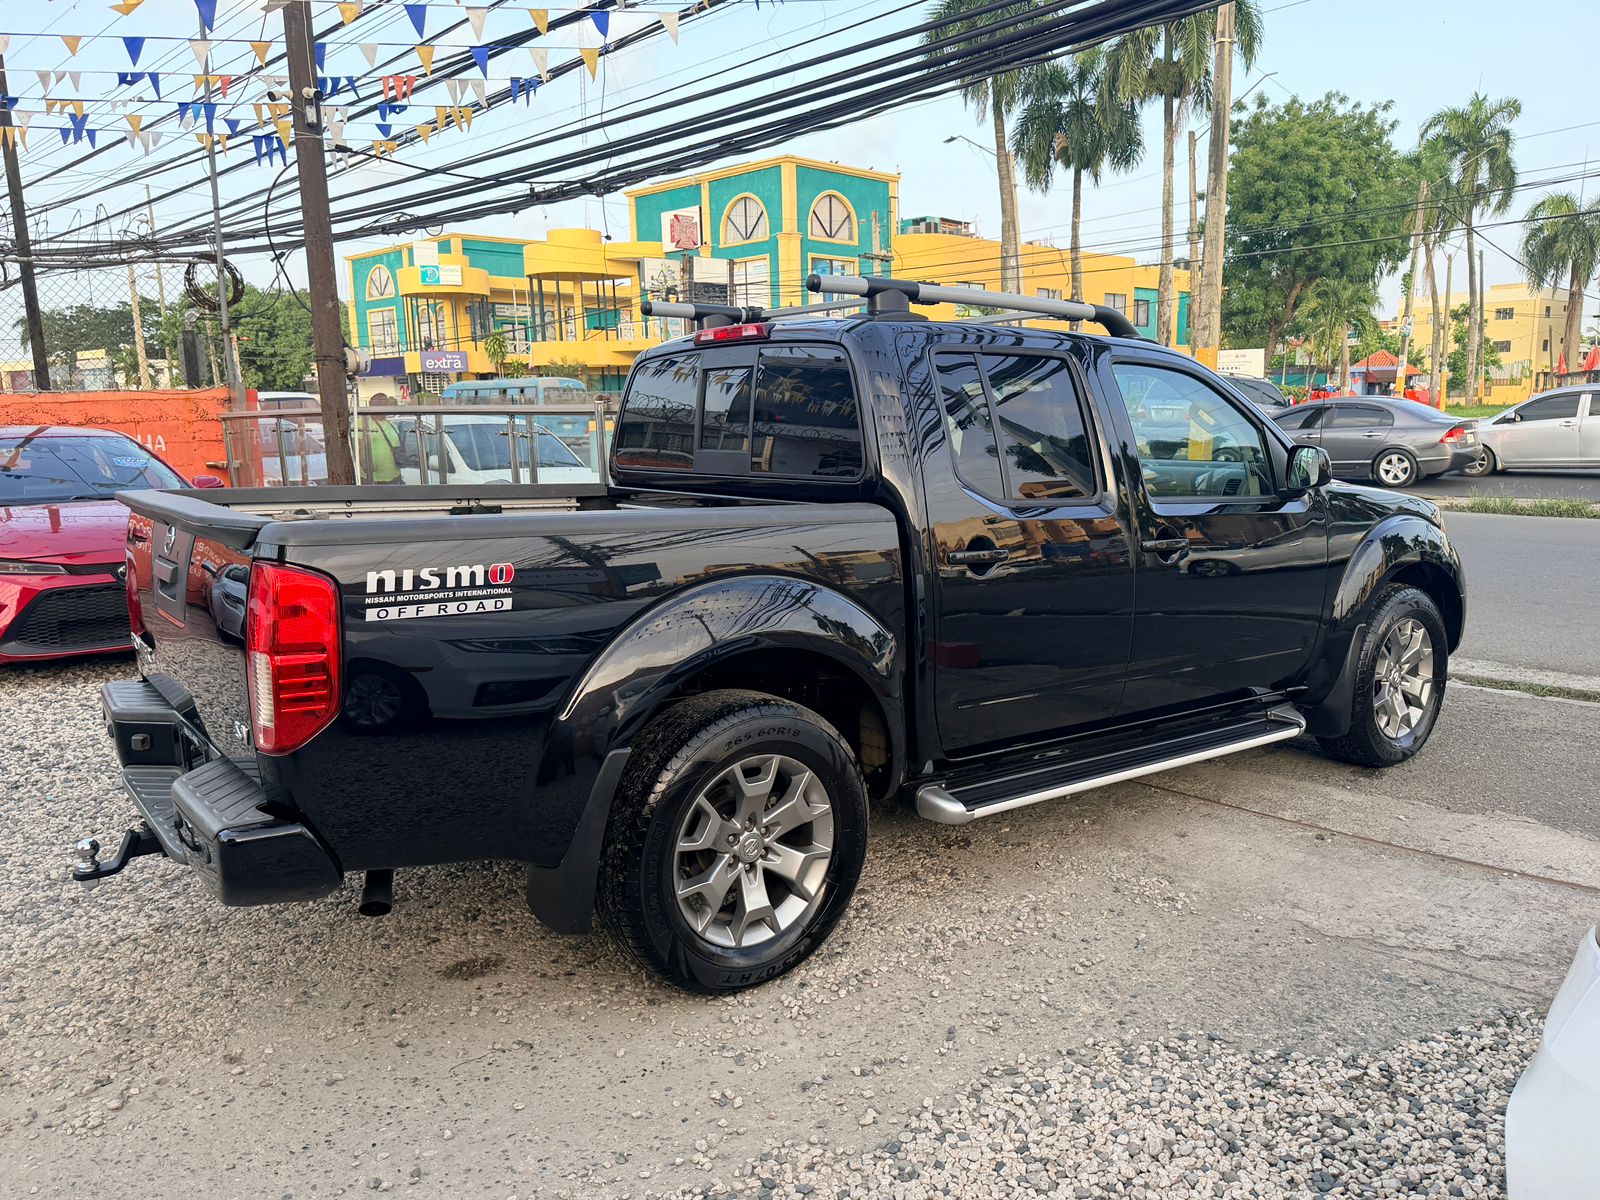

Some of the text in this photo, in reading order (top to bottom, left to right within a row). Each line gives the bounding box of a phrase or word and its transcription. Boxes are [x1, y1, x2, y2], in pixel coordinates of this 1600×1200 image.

[366, 562, 515, 593] nismo
[365, 587, 513, 604] NISSAN MOTORSPORTS INTERNATIONAL
